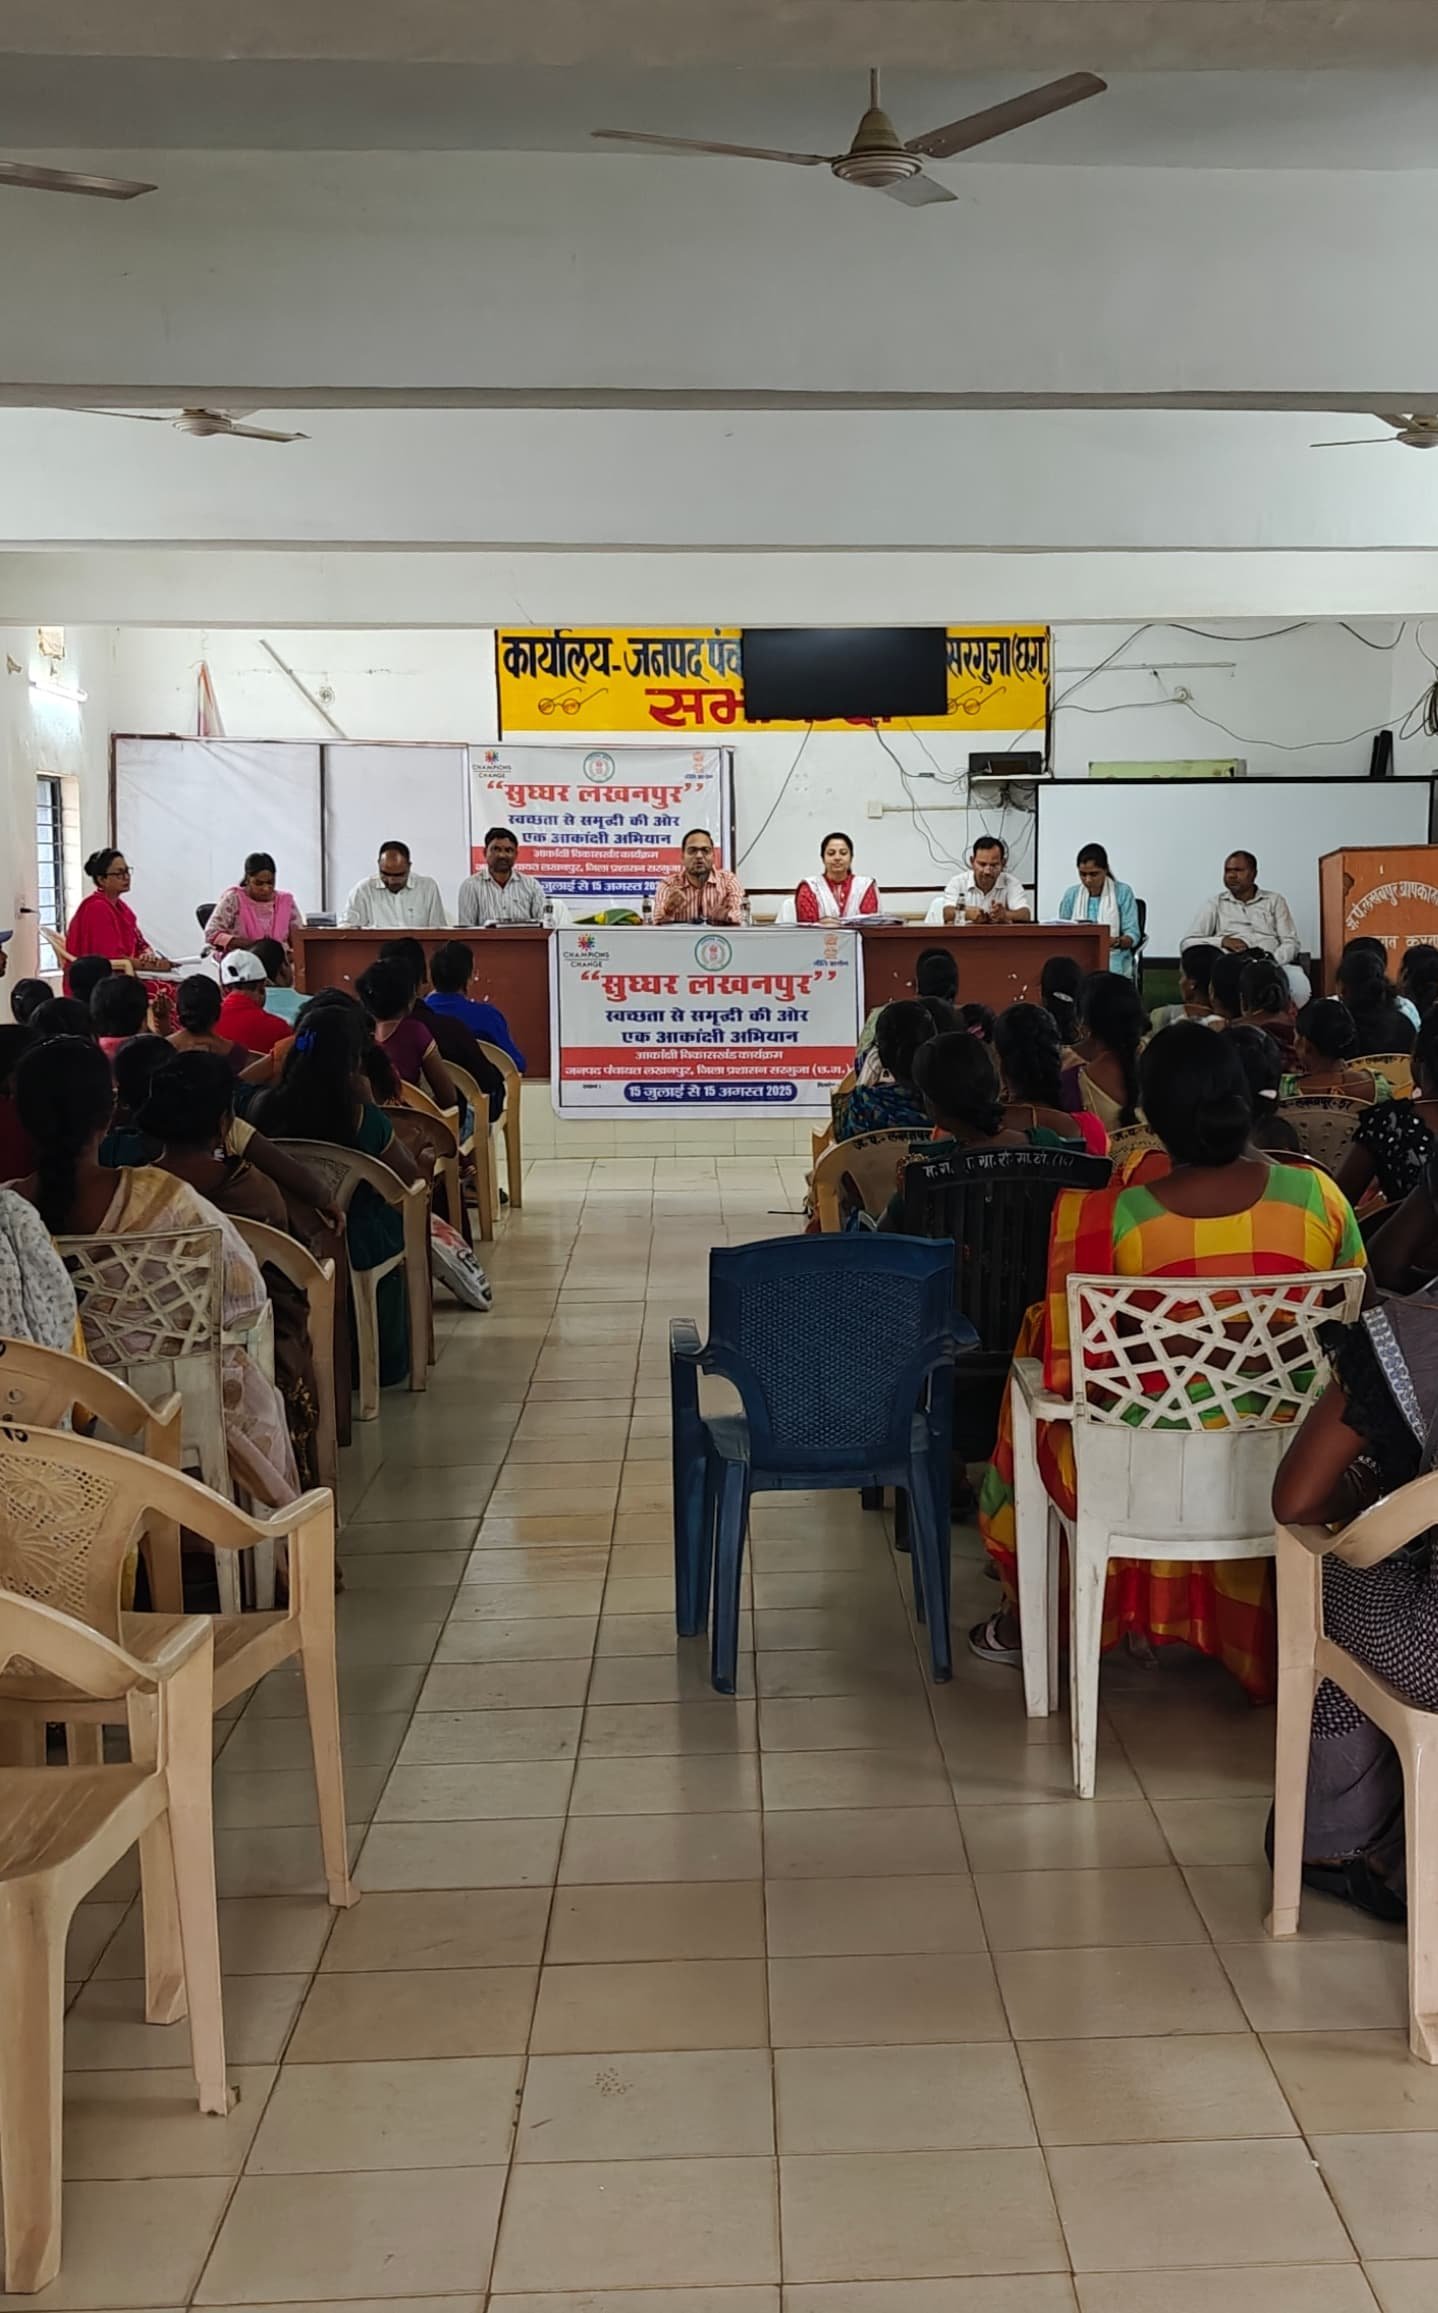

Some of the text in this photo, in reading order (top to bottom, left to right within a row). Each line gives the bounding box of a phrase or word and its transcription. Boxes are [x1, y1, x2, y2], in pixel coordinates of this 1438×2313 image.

[645, 688, 744, 727] सभ
[508, 814, 558, 825] स्वच्छता
[563, 812, 575, 825] से
[629, 814, 649, 827] की
[653, 814, 680, 827] ओर
[522, 830, 671, 845] एक आकांक्षी अभियान
[578, 880, 590, 891] से
[592, 881, 602, 891] 15
[604, 881, 642, 891] अगस्त
[570, 960, 602, 968] CHANGE
[606, 1009, 665, 1023] स्वच्छता
[670, 1007, 685, 1022] से
[748, 1007, 772, 1022] की
[777, 1007, 809, 1022] ओर
[620, 1028, 800, 1043] एक आकांक्षी अभियान
[770, 1065, 809, 1077] सरगुजा
[629, 1084, 792, 1100] 15 जुलाई से 15 अगस्त 2025
